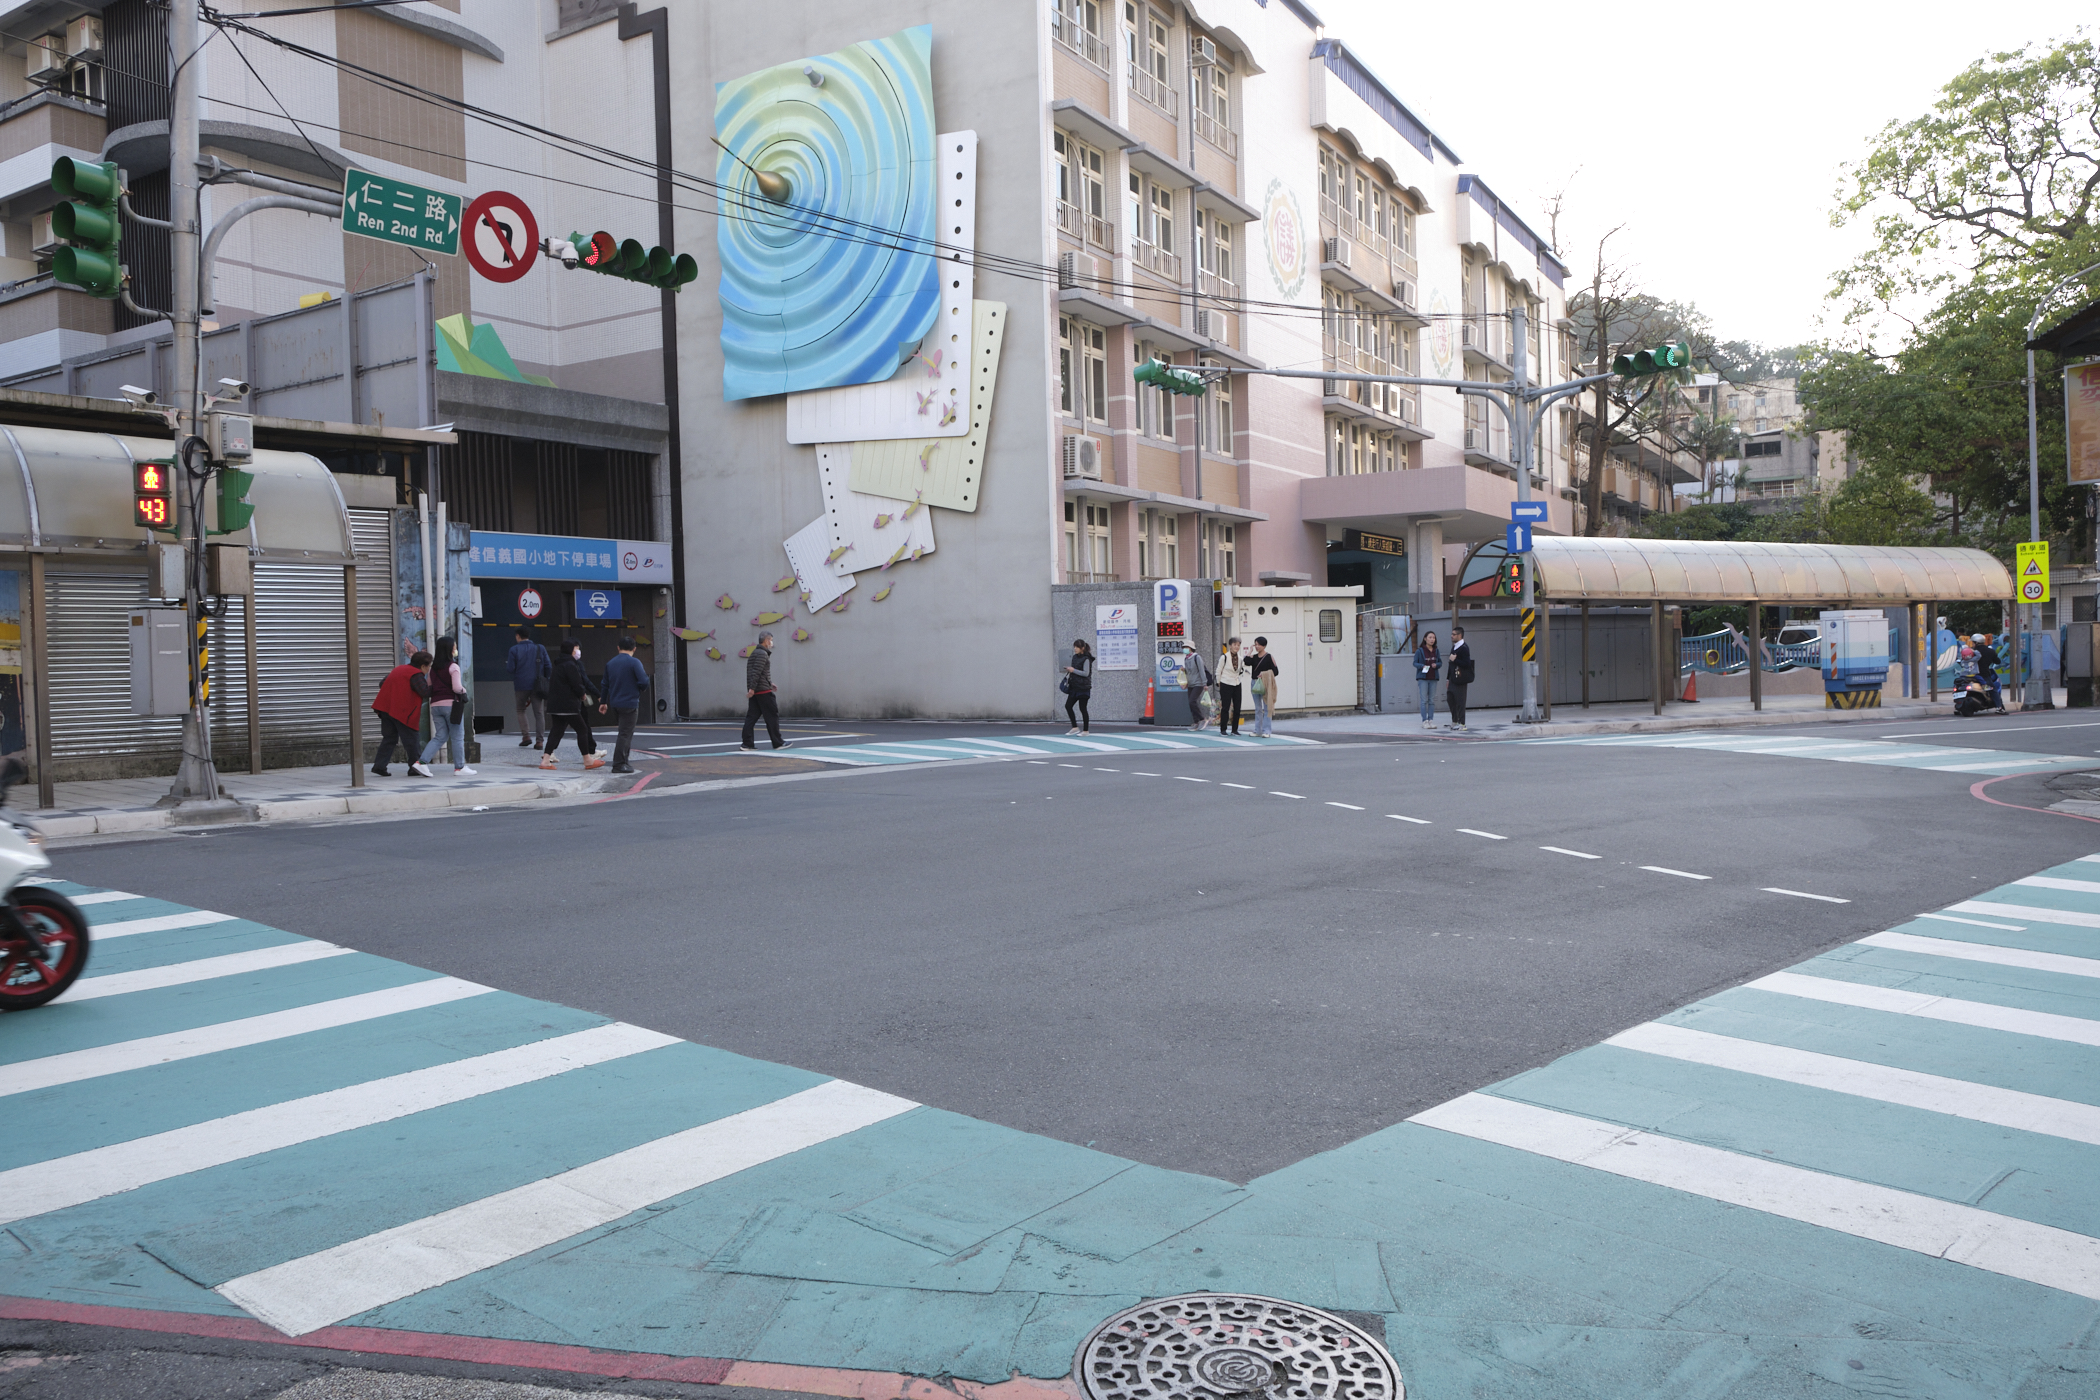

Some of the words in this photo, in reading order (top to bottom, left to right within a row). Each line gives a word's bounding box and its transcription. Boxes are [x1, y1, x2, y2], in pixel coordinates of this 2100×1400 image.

[361, 180, 448, 222] 仁二路
[357, 212, 385, 232] Ren
[391, 220, 417, 239] 2nd
[425, 228, 446, 245] Rd.
[139, 498, 165, 522] 43
[1160, 584, 1178, 612] P
[2026, 586, 2041, 594] 30
[522, 599, 540, 609] 2.0m
[1162, 660, 1173, 668] 30
